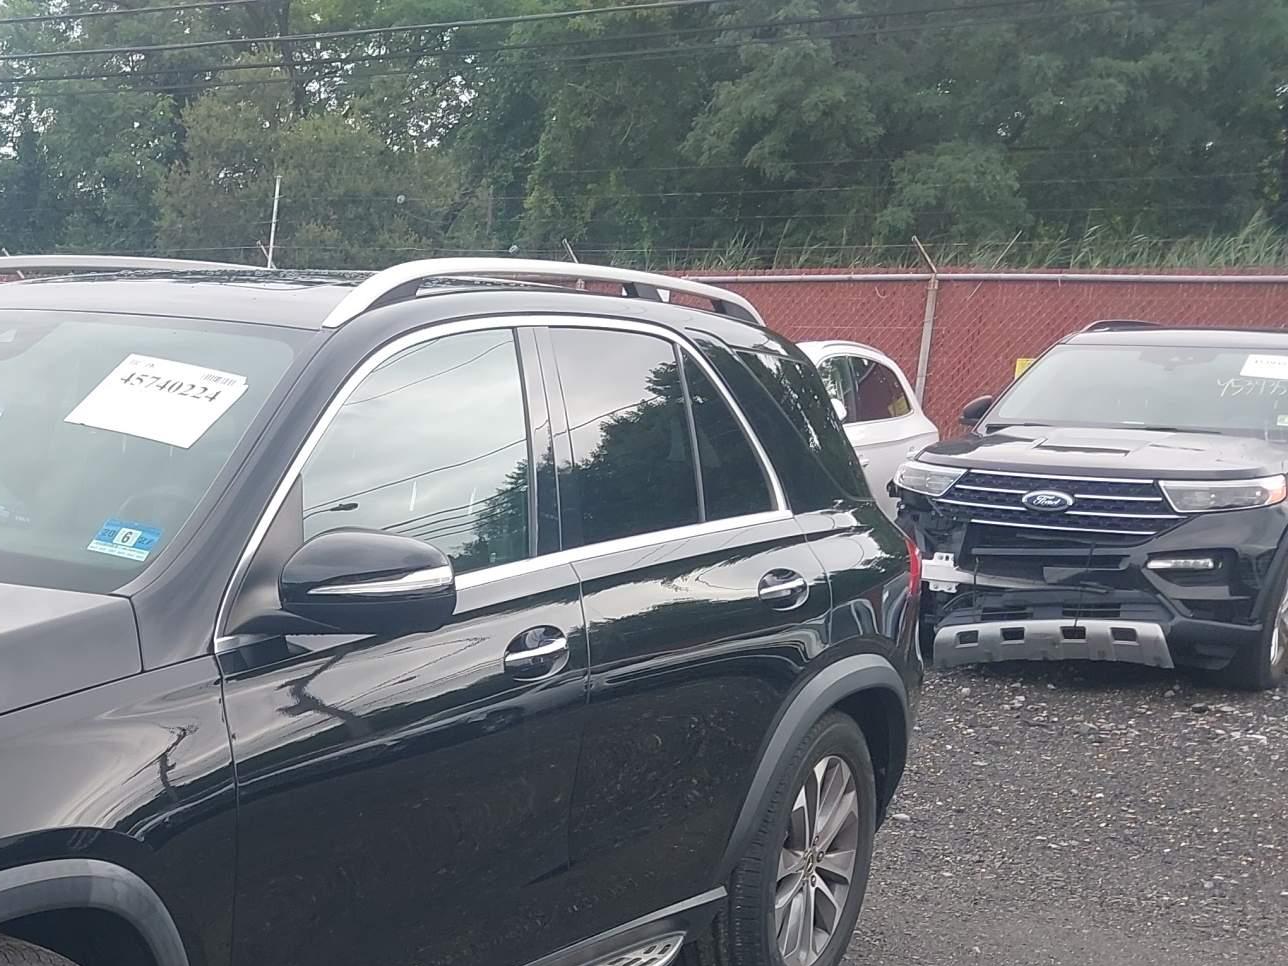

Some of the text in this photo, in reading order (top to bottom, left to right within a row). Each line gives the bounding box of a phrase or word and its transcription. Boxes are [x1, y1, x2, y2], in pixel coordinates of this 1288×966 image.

[120, 372, 223, 403] 45740224
[1032, 494, 1062, 507] Ford
[120, 531, 133, 544] 6
